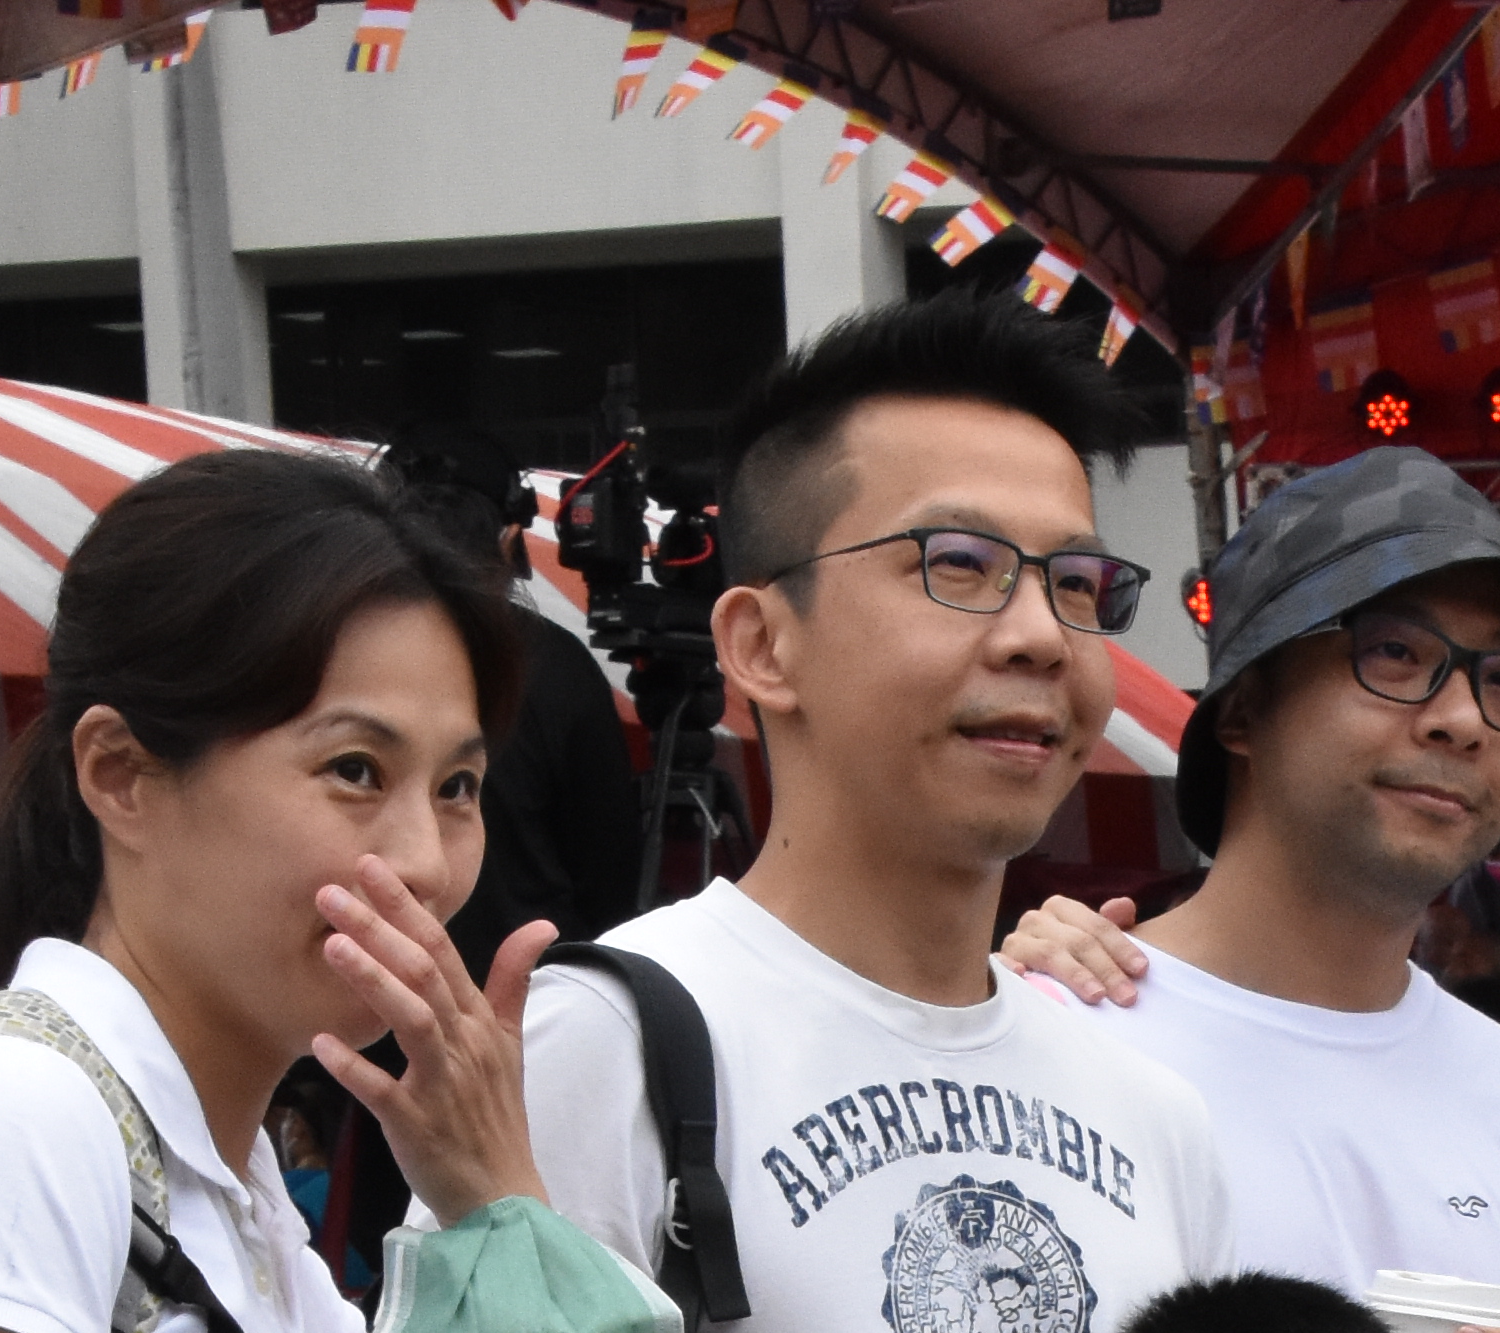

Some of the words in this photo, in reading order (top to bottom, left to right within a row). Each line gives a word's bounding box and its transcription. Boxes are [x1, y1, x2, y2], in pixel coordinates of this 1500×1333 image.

[761, 1078, 1136, 1228] ABERCROMBIE
[996, 1204, 1040, 1237] AND
[1040, 1238, 1077, 1300] FITCH
[1021, 1245, 1050, 1272] NEW
[1039, 1271, 1058, 1312] YORK
